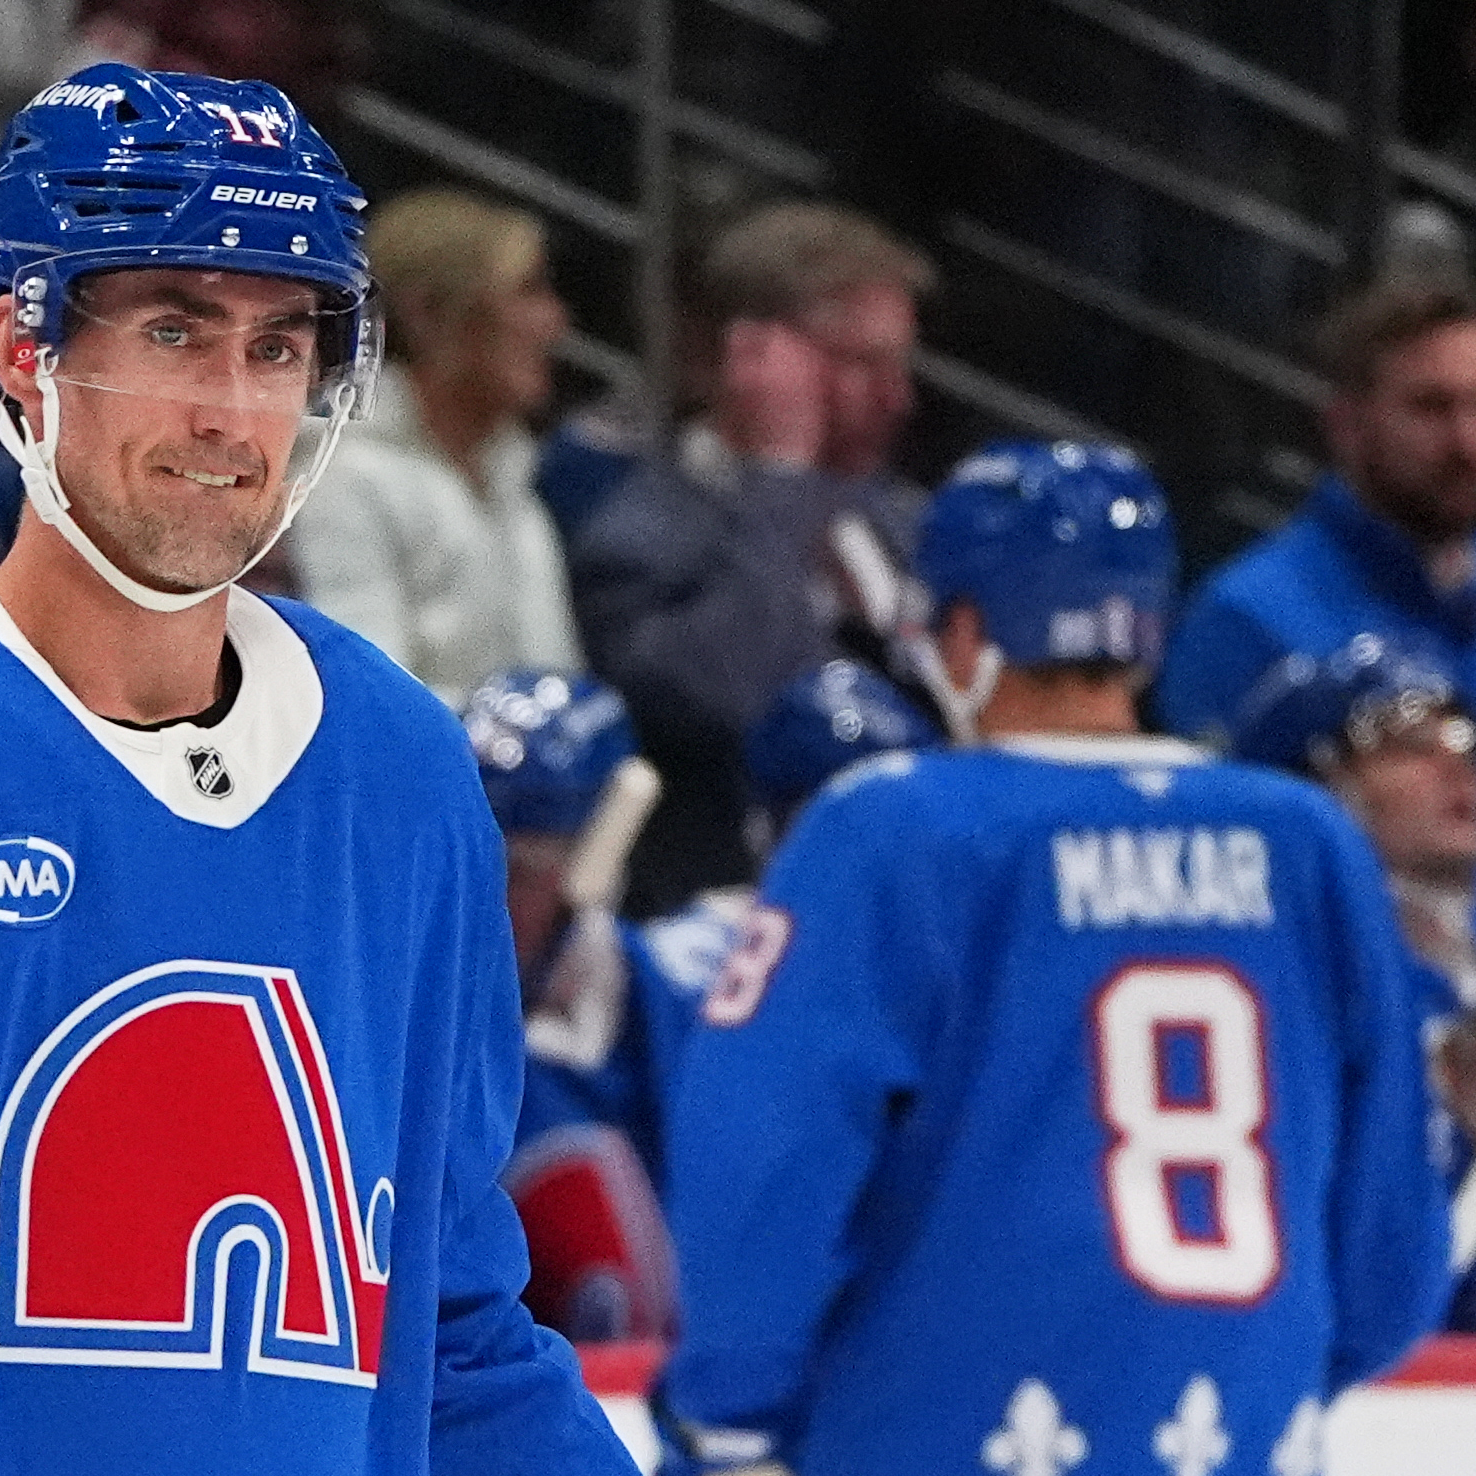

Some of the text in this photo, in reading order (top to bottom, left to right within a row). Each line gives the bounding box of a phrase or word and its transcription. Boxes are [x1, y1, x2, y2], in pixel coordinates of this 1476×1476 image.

[211, 184, 317, 212] BAUER
[1054, 827, 1276, 929] MAKAR
[1092, 959, 1284, 1308] 8
